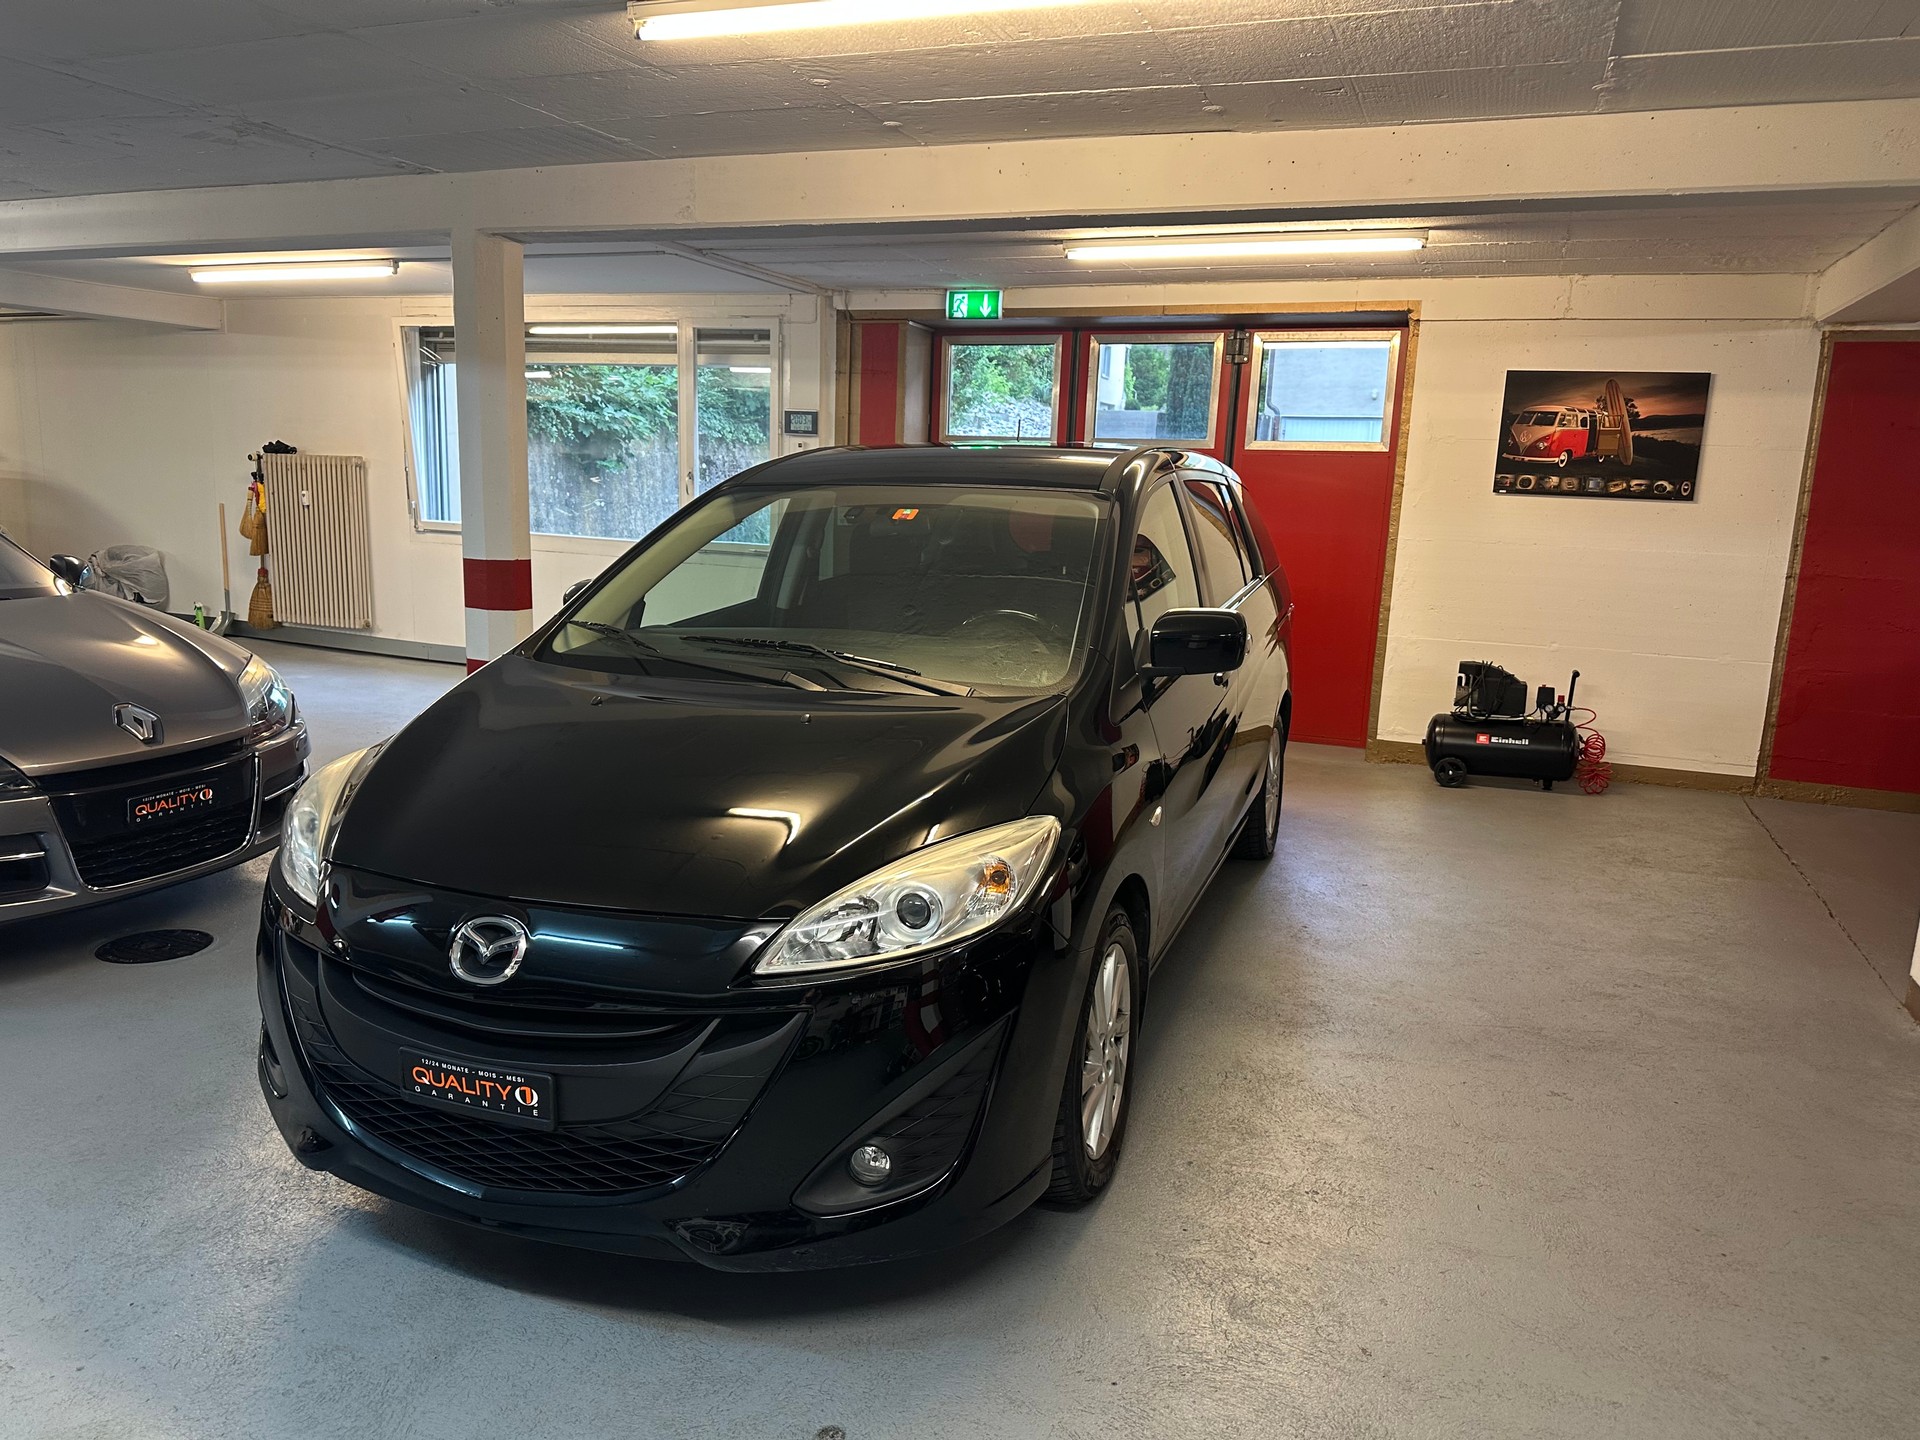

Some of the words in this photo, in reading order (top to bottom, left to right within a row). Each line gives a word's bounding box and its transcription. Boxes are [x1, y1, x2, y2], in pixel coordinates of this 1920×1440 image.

[1490, 736, 1529, 745] Einhell
[135, 791, 199, 816] QUALITY
[136, 799, 213, 823] GARANTIE
[421, 1057, 440, 1067] 12/24
[441, 1062, 469, 1074] MONATE
[478, 1069, 497, 1079] MOIS
[506, 1074, 525, 1083] MESI
[412, 1066, 512, 1101] QUALITY
[414, 1085, 539, 1117] GARANTIE
